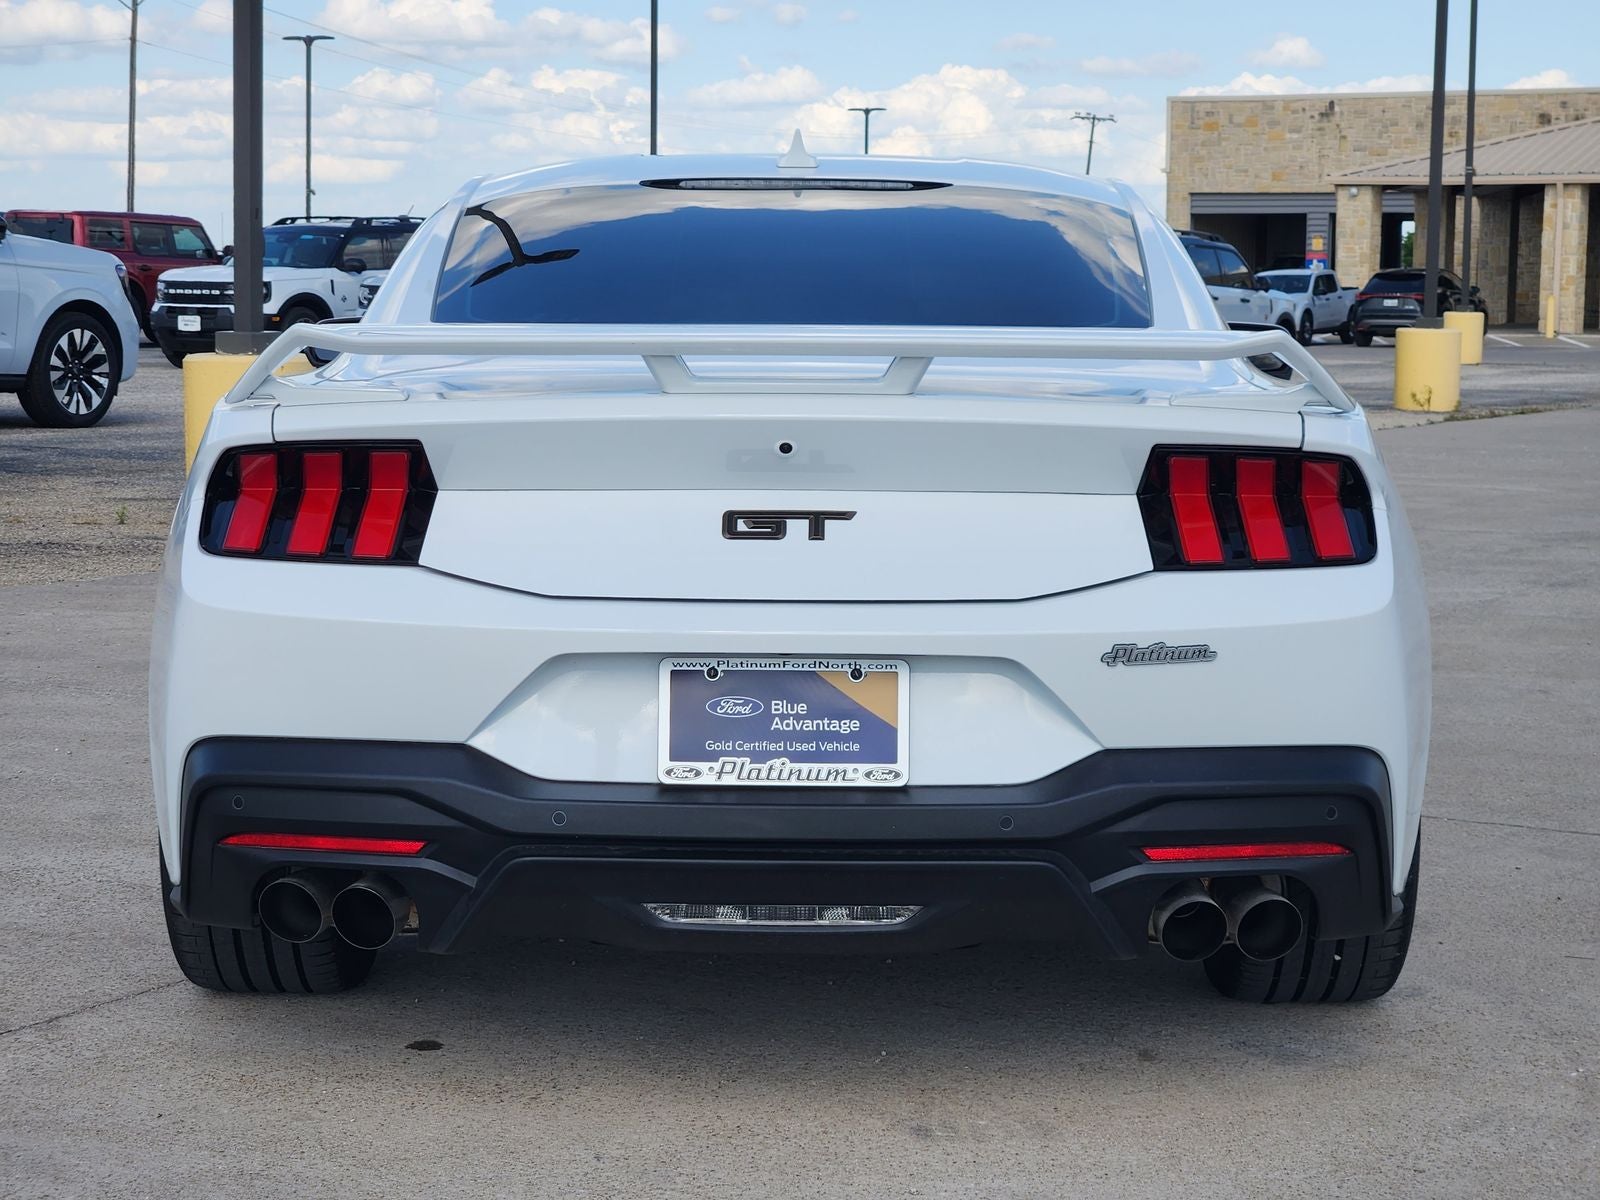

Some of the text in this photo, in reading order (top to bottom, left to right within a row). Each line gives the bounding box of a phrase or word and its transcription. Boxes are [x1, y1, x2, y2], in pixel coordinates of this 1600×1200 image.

[722, 510, 857, 540] GT
[1100, 642, 1217, 667] Platinum
[672, 660, 898, 670] www.PlatinumFordNorth.com
[717, 699, 752, 714] Ford
[771, 700, 808, 714] Blue
[770, 716, 860, 734] Advantage
[705, 740, 860, 752] Gold Certified Used Vehicle
[671, 767, 696, 778] Ford
[715, 759, 859, 782] Platinum
[869, 769, 896, 781] Ford
